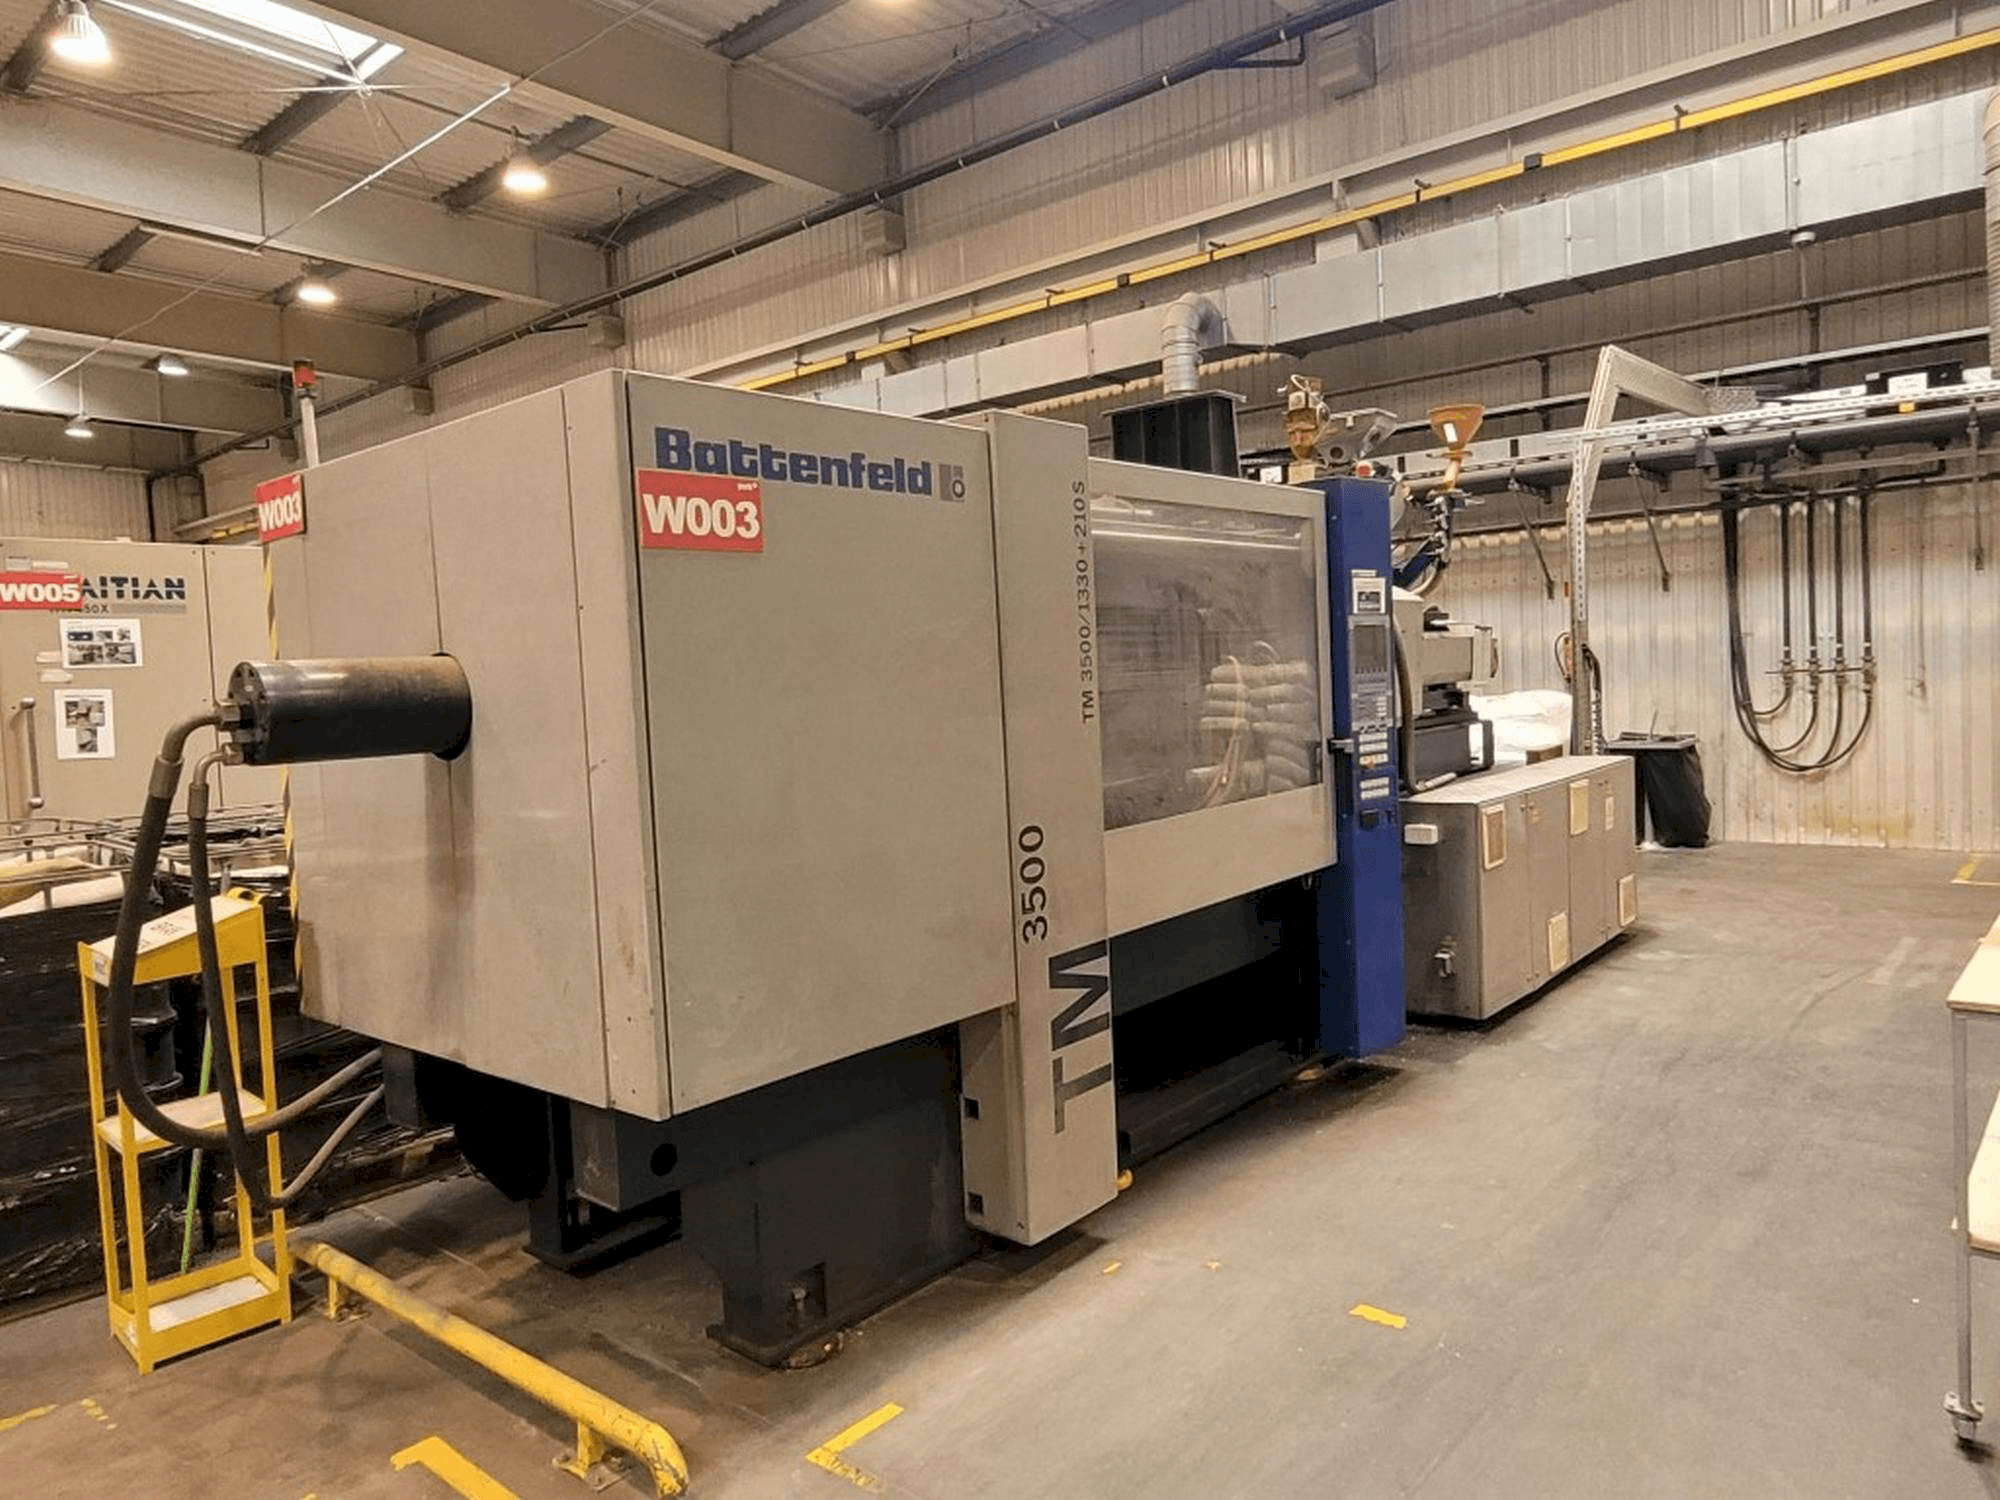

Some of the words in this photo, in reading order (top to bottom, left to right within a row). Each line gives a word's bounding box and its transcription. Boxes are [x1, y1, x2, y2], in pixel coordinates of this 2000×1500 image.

[655, 427, 933, 496] Battenfeld
[259, 491, 302, 532] W003
[642, 494, 761, 539] W003
[0, 583, 80, 603] W005
[80, 576, 187, 600] AITIAN
[1081, 690, 1095, 724] TM
[1018, 825, 1049, 943] 3500
[1049, 939, 1113, 1135] TM
